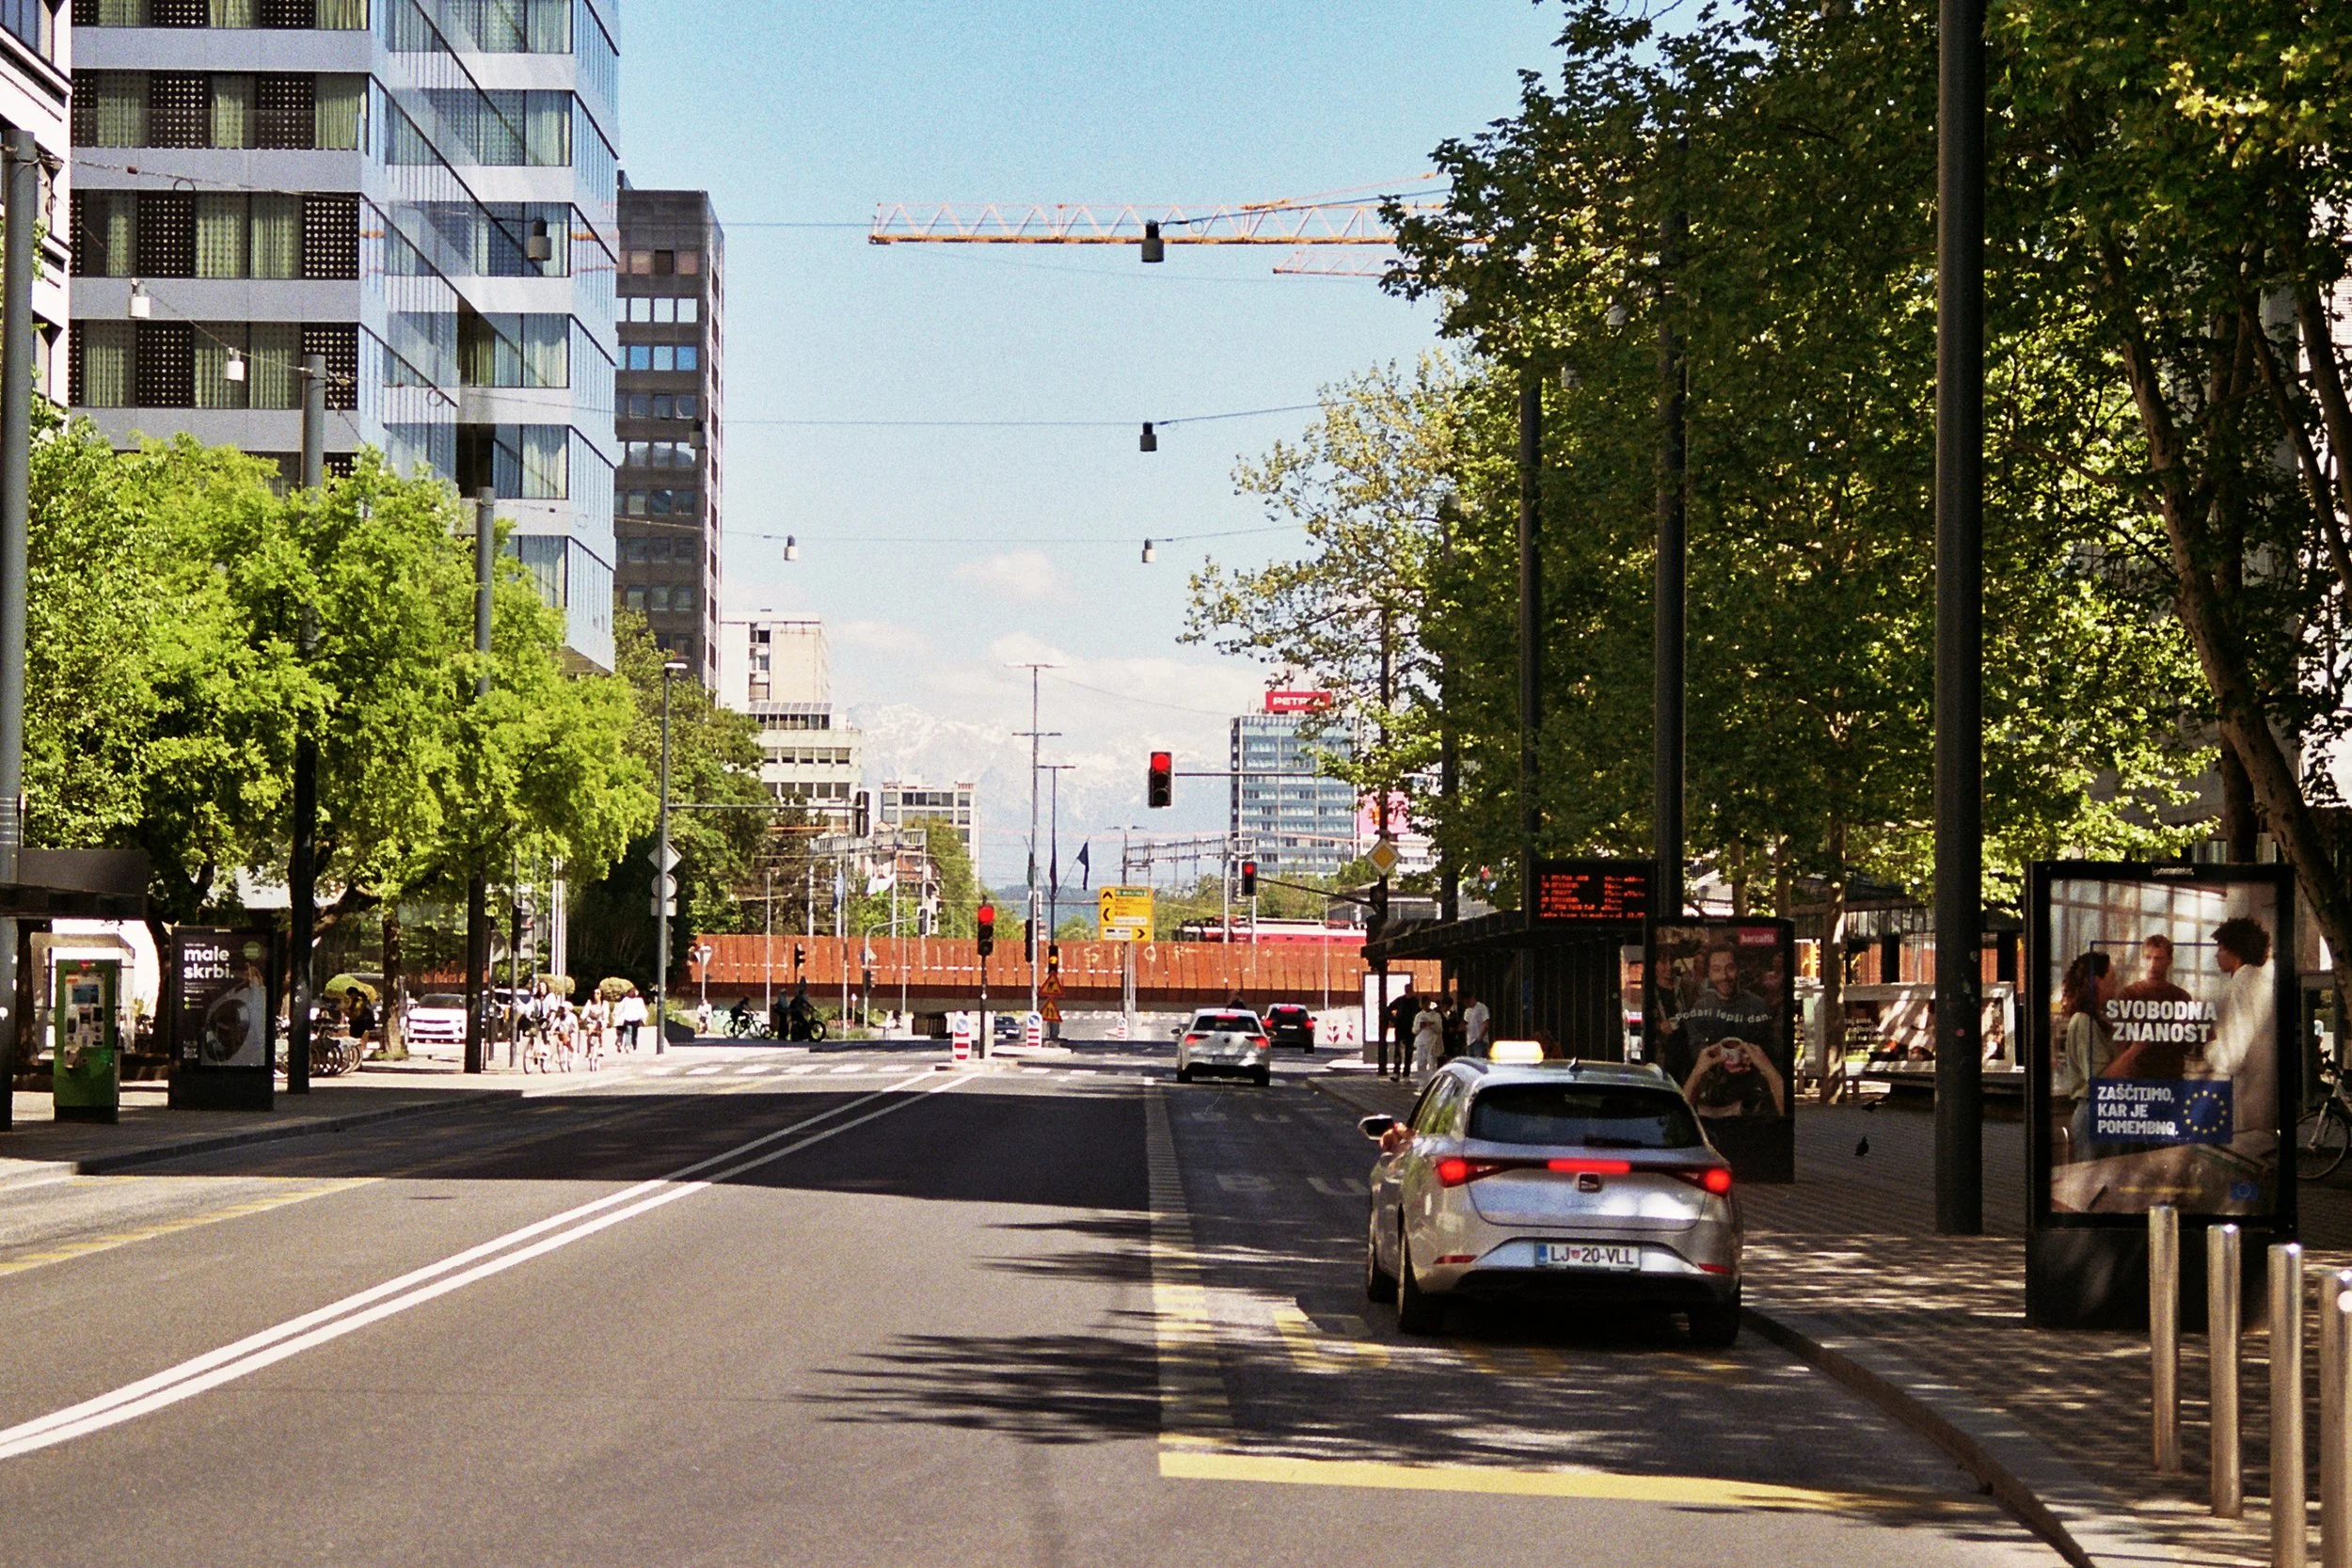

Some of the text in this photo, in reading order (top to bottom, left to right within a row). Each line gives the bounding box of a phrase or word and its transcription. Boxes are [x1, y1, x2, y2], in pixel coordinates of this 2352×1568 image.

[183, 945, 230, 961] male
[183, 963, 234, 979] skrbi.
[2106, 1000, 2218, 1021] SVOBODNA
[2112, 1022, 2212, 1042] ZNANOST
[2097, 1084, 2175, 1103] ZAŠČITIMO,
[2097, 1103, 2149, 1117] KAR JE
[2097, 1119, 2180, 1136] POMEMBNO.
[1550, 1247, 1634, 1264] LJ 20-VLL
